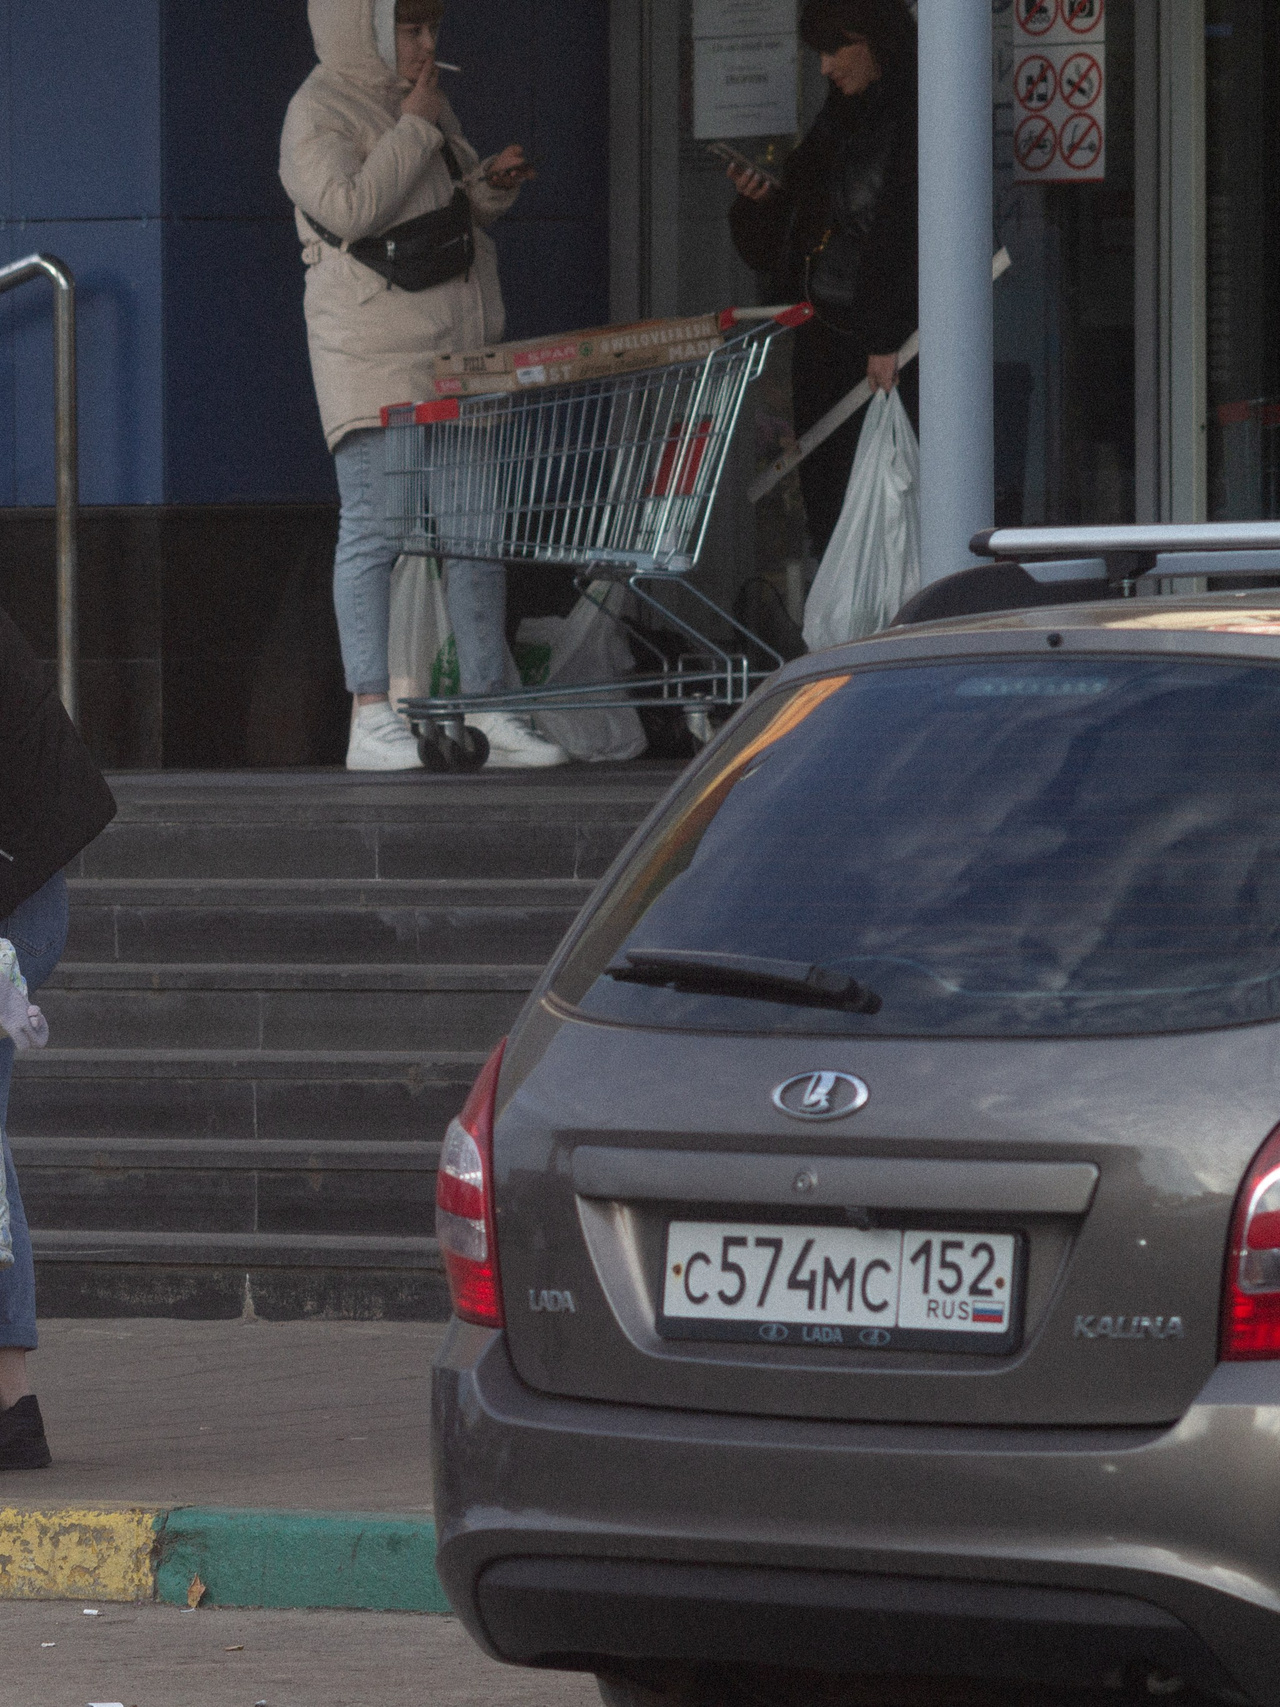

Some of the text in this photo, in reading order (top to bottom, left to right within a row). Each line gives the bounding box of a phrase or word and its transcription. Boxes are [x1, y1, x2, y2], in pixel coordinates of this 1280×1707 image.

[528, 346, 576, 363] SPAR
[683, 1236, 892, 1314] C574MC
[910, 1239, 997, 1297] 152
[528, 1288, 576, 1313] LADA
[926, 1298, 970, 1321] RUS
[801, 1326, 843, 1343] LADA
[1073, 1314, 1184, 1339] KALINA
